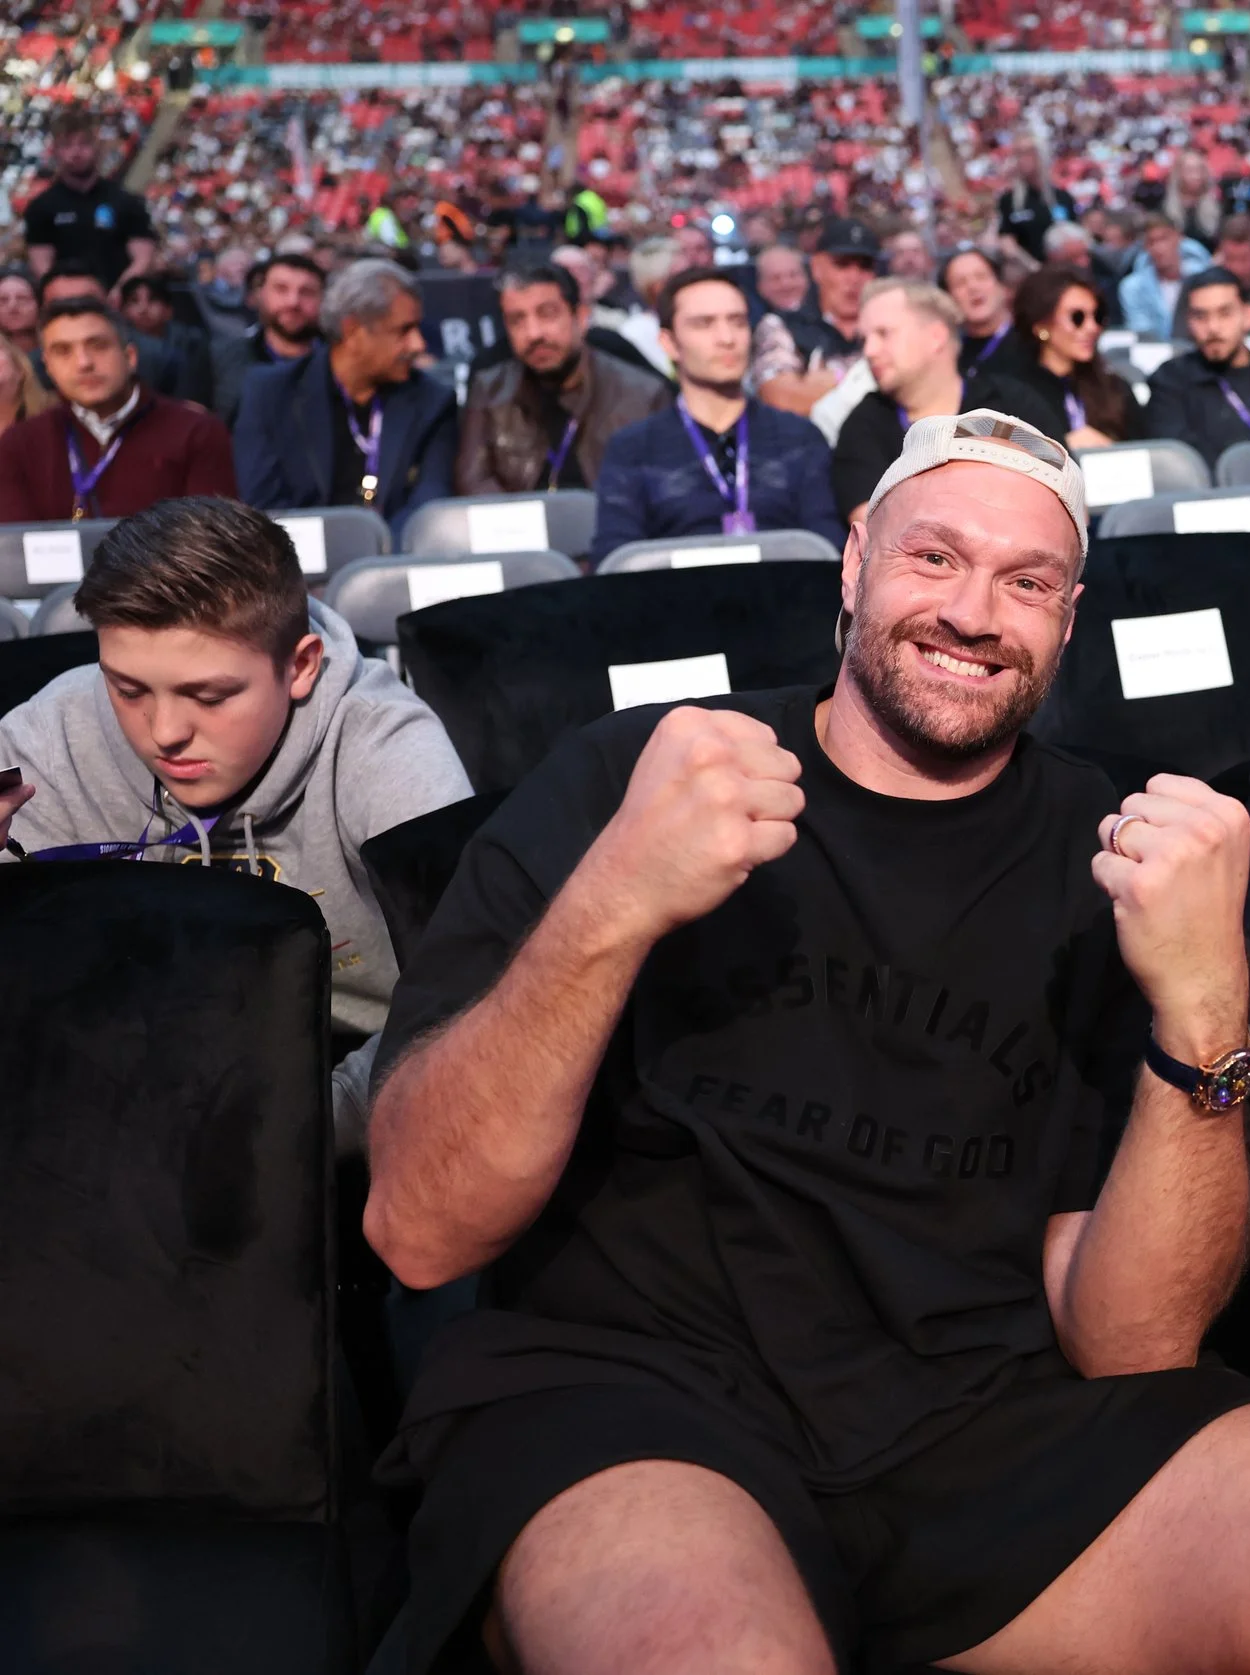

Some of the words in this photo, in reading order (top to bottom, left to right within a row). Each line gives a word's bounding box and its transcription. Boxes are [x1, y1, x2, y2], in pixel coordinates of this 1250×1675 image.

[686, 1073, 832, 1143] FEAR
[845, 1111, 910, 1167] OF
[922, 1131, 1016, 1180] GOD
